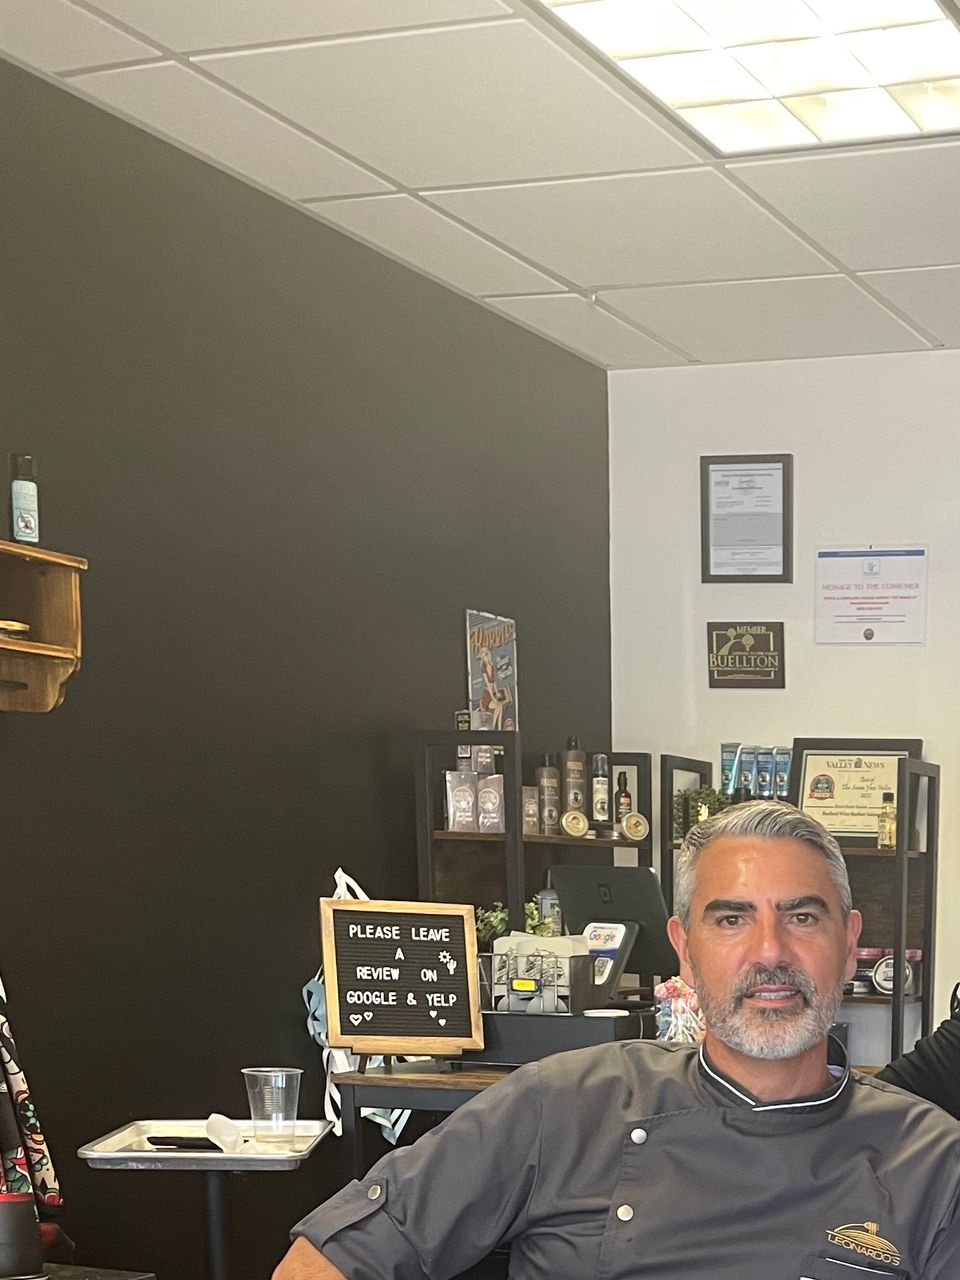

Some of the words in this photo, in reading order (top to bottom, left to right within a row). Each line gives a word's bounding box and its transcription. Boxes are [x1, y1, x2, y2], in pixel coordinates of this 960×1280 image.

[709, 653, 779, 668] BUELLTON
[348, 924, 401, 940] PLEASE
[411, 927, 451, 942] LEAVE
[590, 929, 617, 944] Gogle
[394, 947, 405, 961] A
[356, 966, 400, 981] REVIEW
[420, 968, 438, 982] ON
[346, 990, 397, 1006] GOOGLE
[406, 992, 418, 1006] &
[426, 993, 458, 1007] YELP
